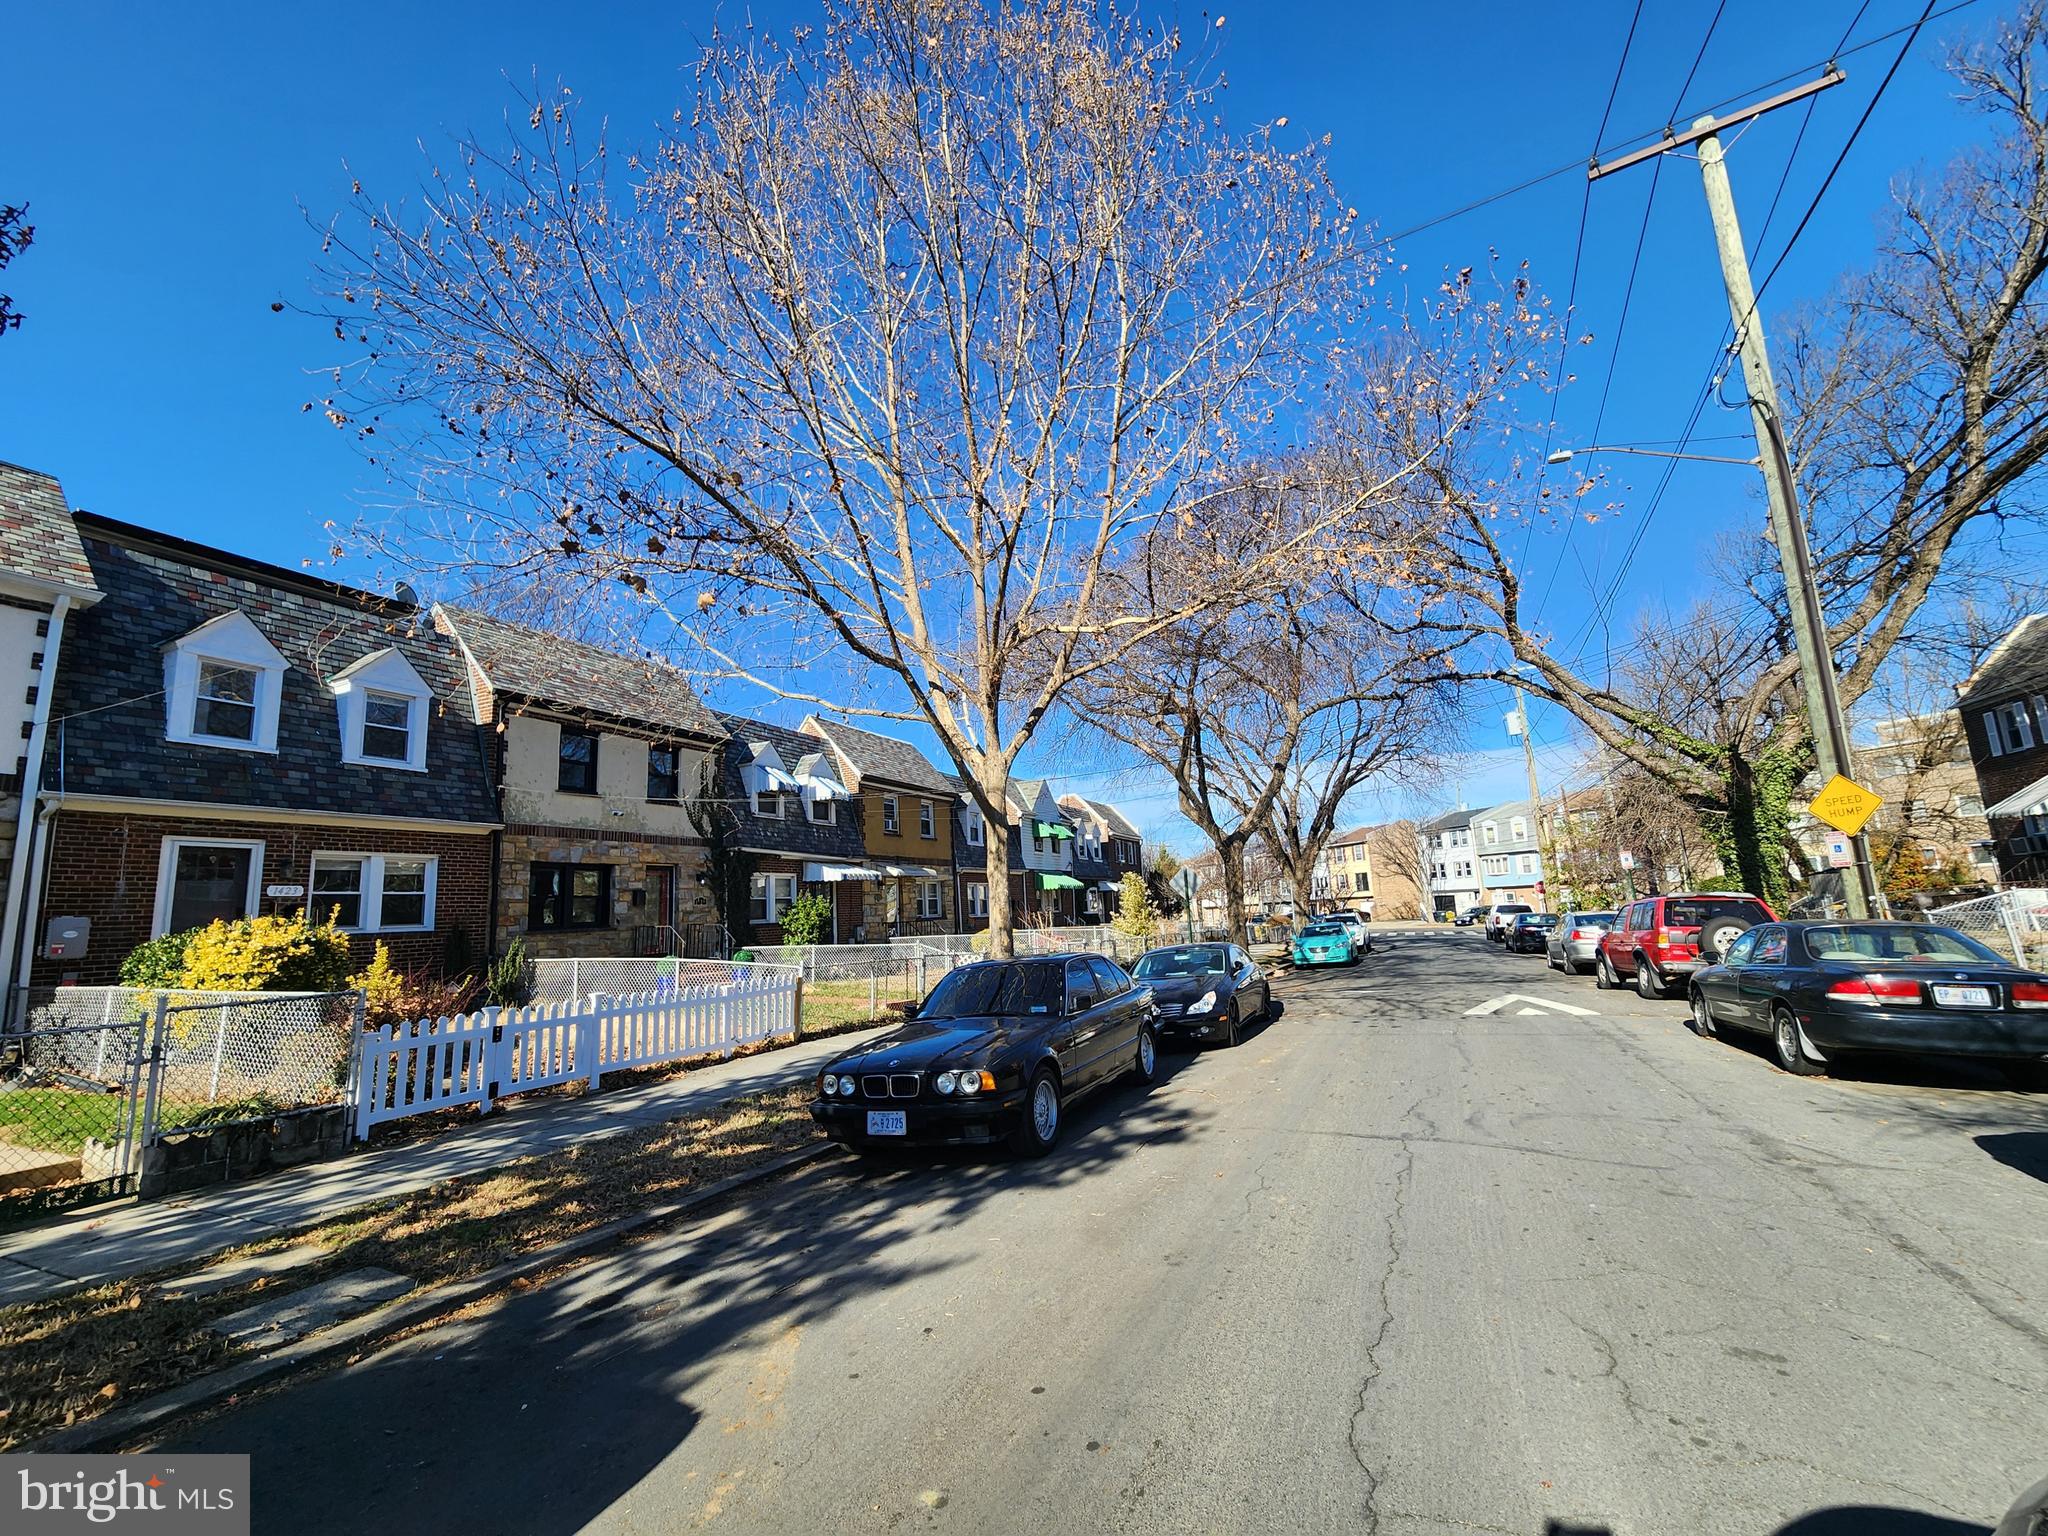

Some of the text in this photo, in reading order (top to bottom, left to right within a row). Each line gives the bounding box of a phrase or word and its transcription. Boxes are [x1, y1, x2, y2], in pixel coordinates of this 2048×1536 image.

[1825, 794, 1862, 807] SPEED
[1829, 807, 1863, 818] HUMP
[272, 886, 299, 896] 1423
[885, 1117, 904, 1129] 2725
